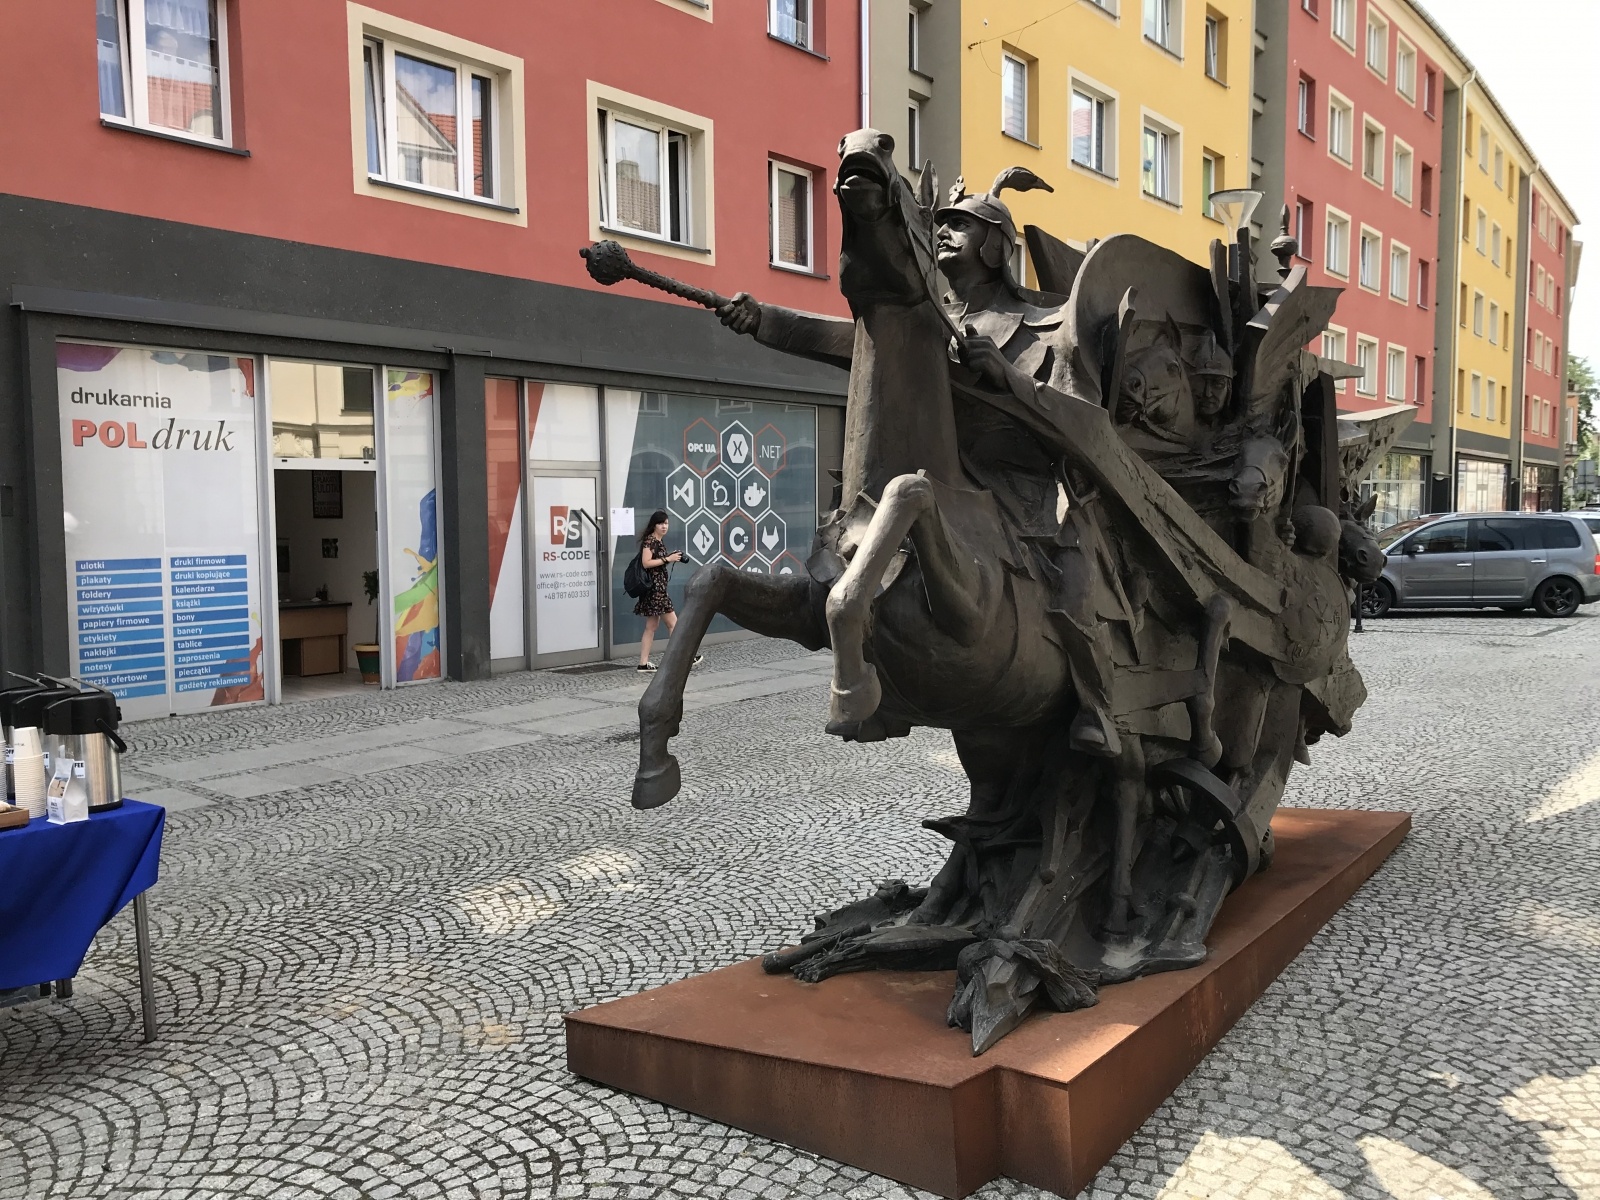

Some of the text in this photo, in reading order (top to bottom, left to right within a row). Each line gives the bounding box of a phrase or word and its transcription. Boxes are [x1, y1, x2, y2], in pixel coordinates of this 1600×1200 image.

[71, 387, 172, 409] drukarnia
[687, 443, 716, 453] OPC UA
[759, 445, 781, 459] .NET
[553, 516, 580, 540] RS
[543, 550, 590, 561] RS-CODE
[80, 561, 105, 570] ulotki
[174, 557, 226, 566] druki firmowe
[174, 570, 231, 580] druki kopiujące
[540, 570, 593, 579] www.rs-code.com
[81, 576, 112, 586] plakaty
[537, 580, 595, 590] office@rs-code.com
[175, 585, 215, 594] kalendarze
[81, 591, 111, 599] foldery
[82, 603, 124, 614] wizytówki
[175, 599, 200, 609] książki
[83, 616, 150, 629] papiery firmowe
[176, 614, 195, 622] bony
[176, 627, 203, 635] banery
[83, 633, 117, 643] etykiety
[177, 640, 203, 649] tablice
[84, 647, 117, 657] naklejki
[178, 652, 221, 663] zaproszenia
[84, 663, 112, 672] notesy
[178, 666, 211, 678] pieczątki
[111, 674, 148, 684] ofertowe
[178, 676, 248, 691] gadżety reklamowe
